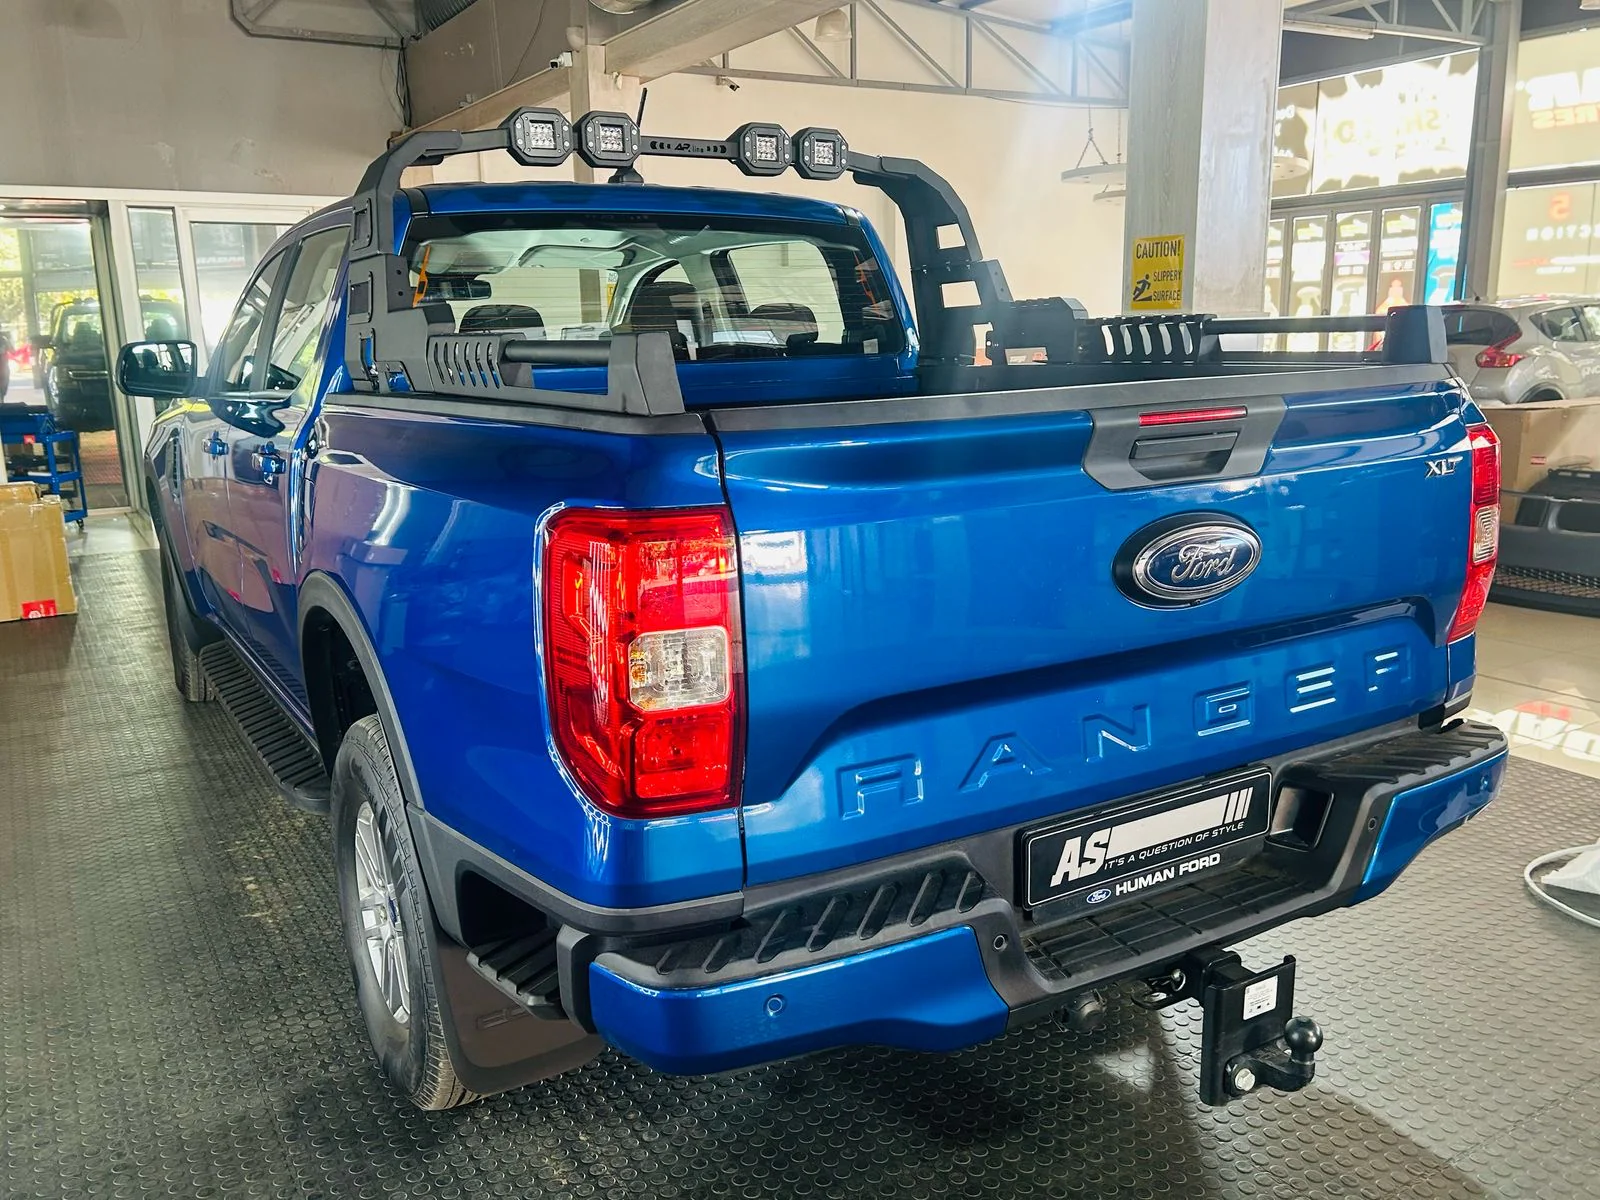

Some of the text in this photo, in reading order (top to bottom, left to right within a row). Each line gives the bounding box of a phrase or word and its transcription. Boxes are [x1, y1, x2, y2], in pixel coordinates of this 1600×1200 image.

[1135, 240, 1181, 259] CAUTION!
[1152, 270, 1183, 282] SLIPPERY
[1152, 290, 1181, 302] SURFACE
[1425, 456, 1463, 479] XLT
[1171, 543, 1237, 583] Ford
[838, 645, 1412, 820] RANGER
[1050, 827, 1112, 887] AS
[1104, 821, 1245, 870] IT'S A QUESTION OF STYLE
[1115, 867, 1175, 896] HUMAN
[1179, 853, 1221, 876] FORD
